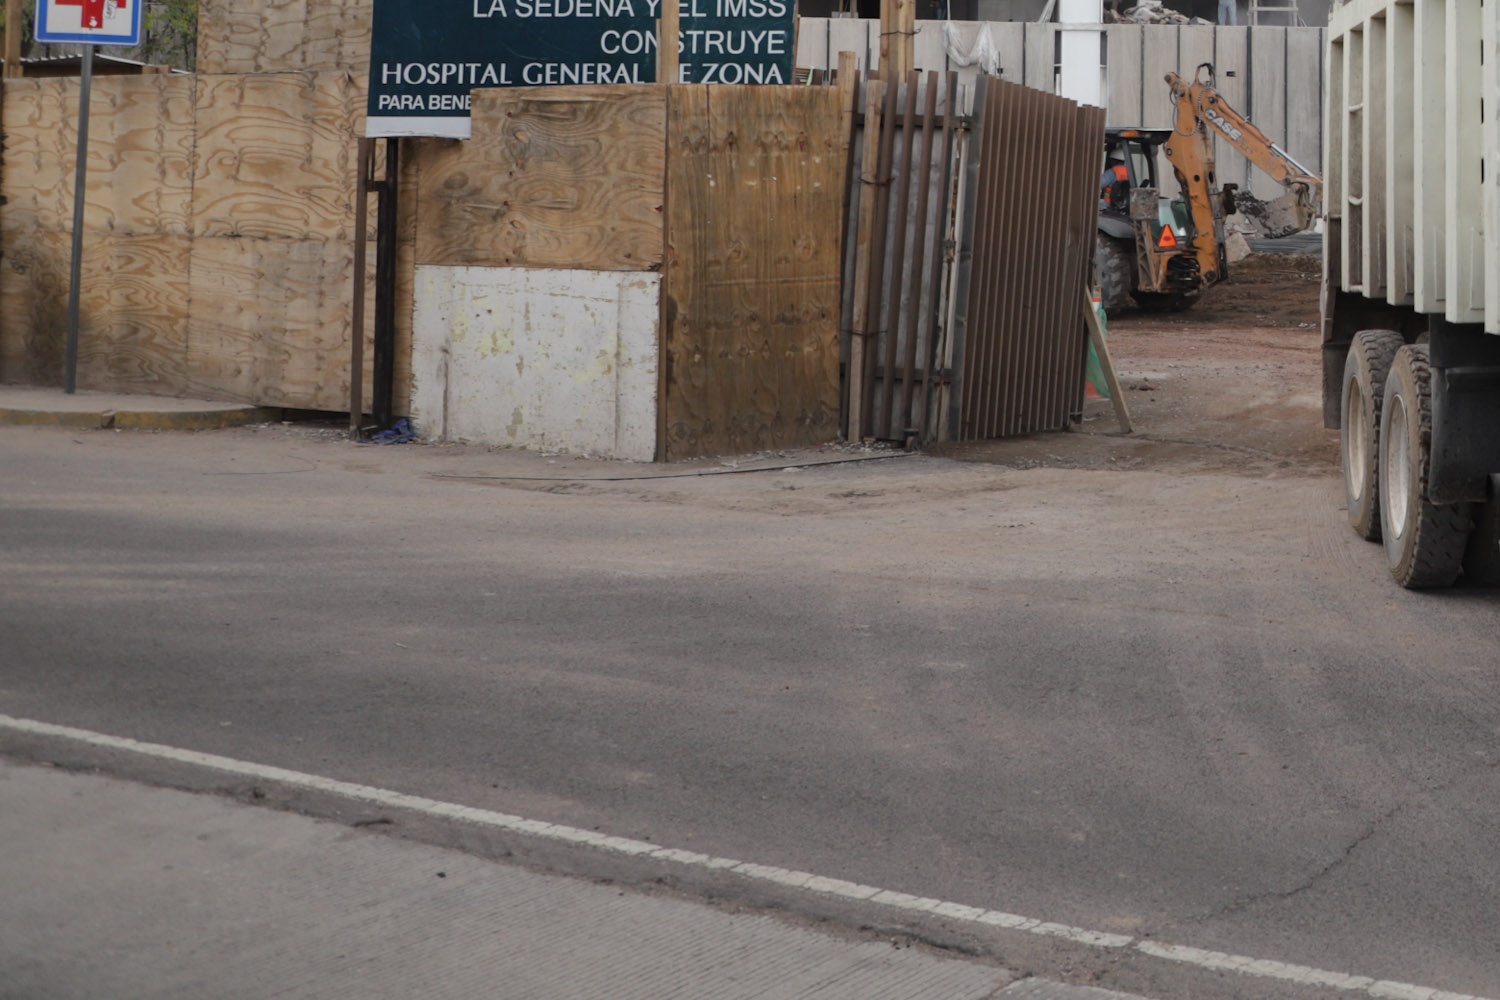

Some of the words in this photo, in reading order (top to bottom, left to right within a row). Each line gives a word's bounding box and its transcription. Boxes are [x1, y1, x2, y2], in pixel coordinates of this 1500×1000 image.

[382, 62, 512, 85] HOSPITAL
[522, 62, 645, 84] GENERAL
[701, 62, 783, 85] ZONA
[378, 94, 425, 110] PARA
[1205, 109, 1243, 140] CASE
